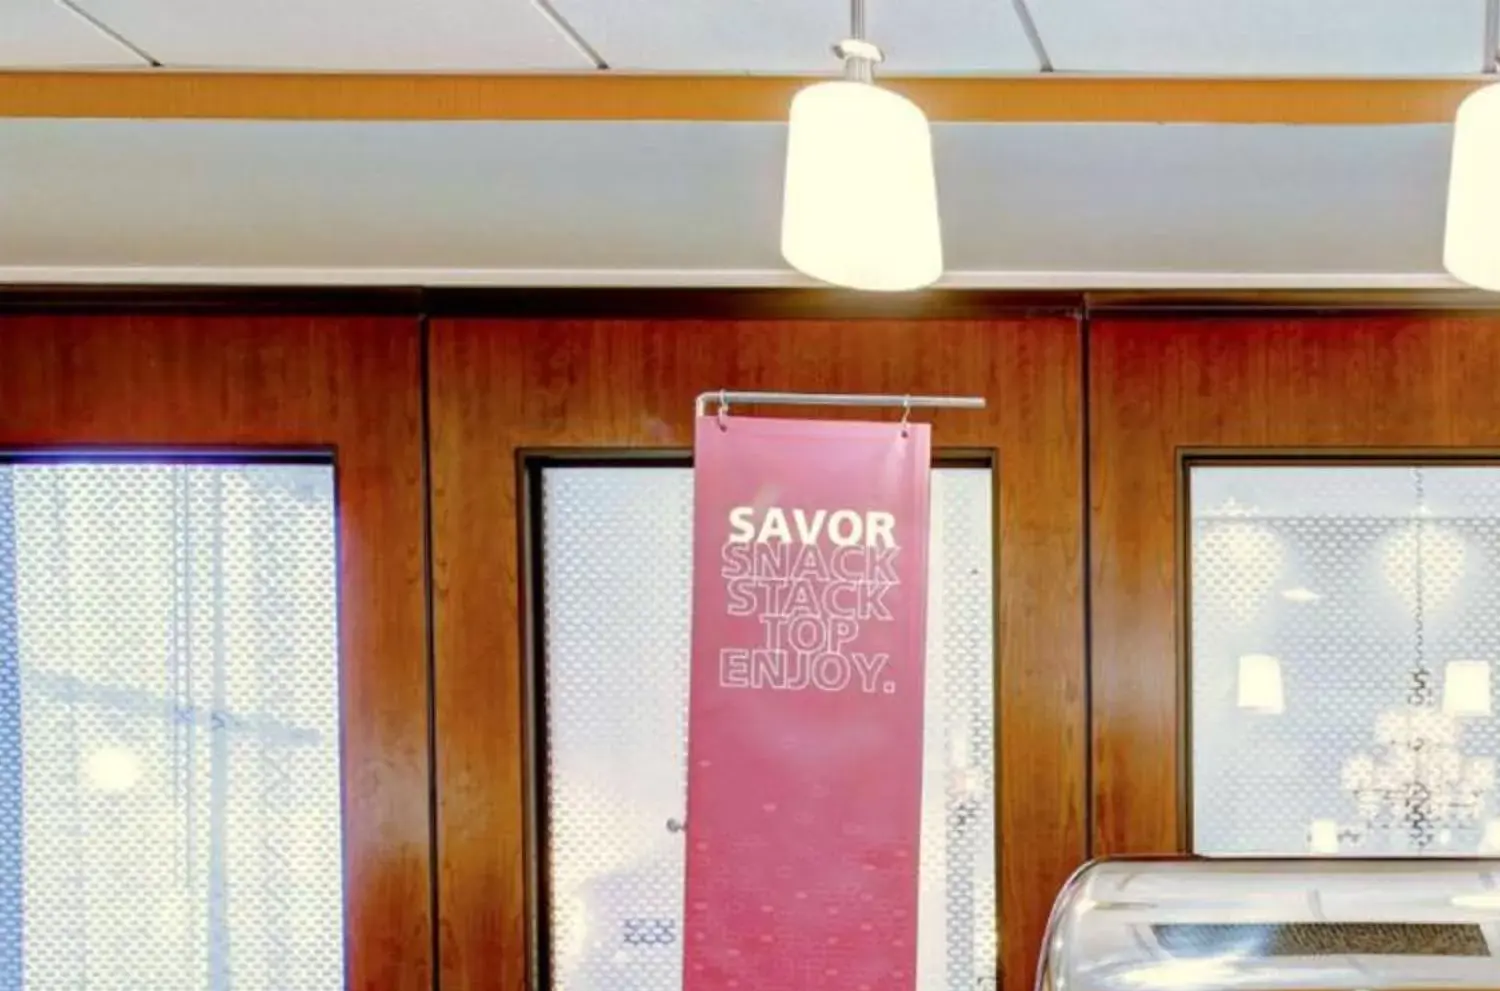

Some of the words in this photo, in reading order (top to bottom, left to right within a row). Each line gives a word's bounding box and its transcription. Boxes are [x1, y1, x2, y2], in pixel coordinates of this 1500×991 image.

[728, 506, 897, 548] SAVOR
[720, 541, 901, 586] SNACK
[726, 576, 895, 621] STACK
[758, 613, 859, 656] TOP
[719, 648, 896, 693] ENJOY.
